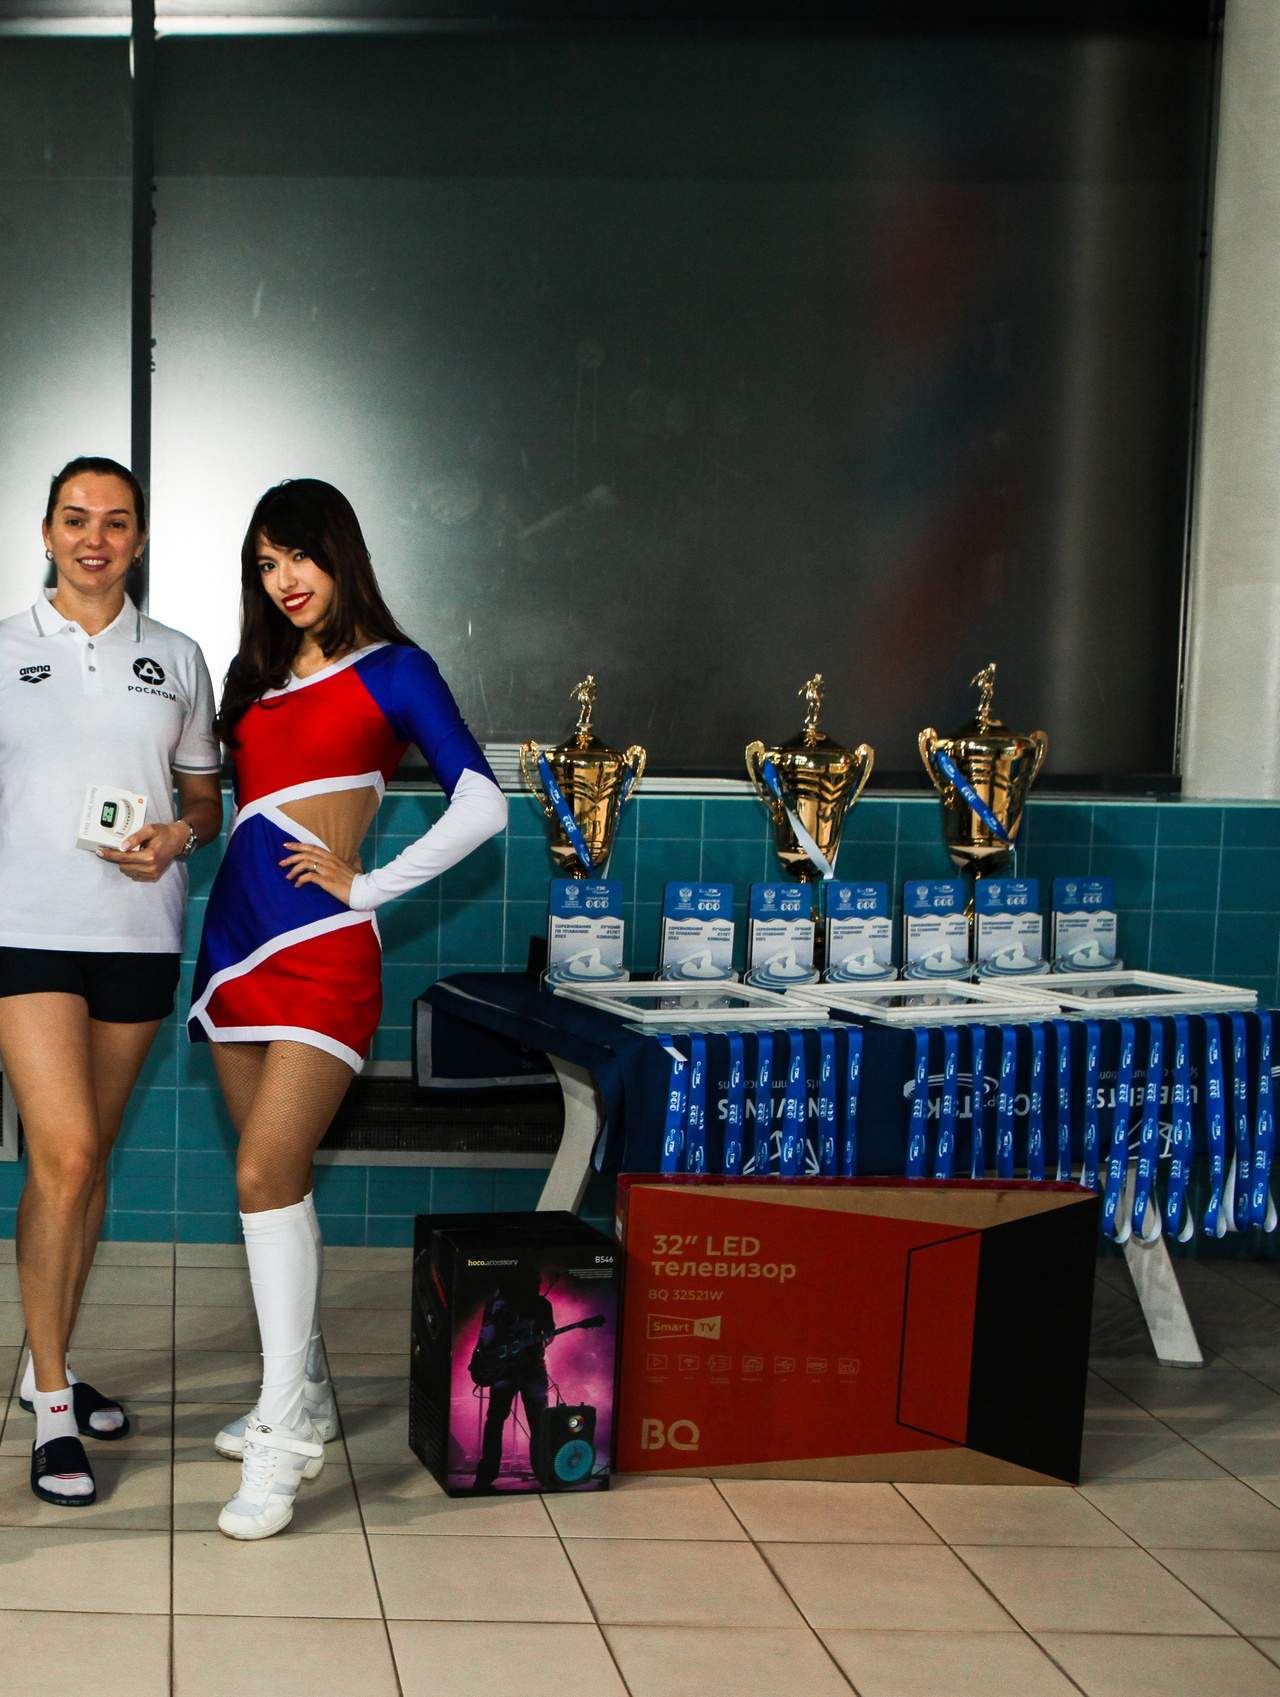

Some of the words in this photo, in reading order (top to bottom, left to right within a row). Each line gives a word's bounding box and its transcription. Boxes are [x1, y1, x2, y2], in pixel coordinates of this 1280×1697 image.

[19, 664, 51, 676] arena
[127, 685, 177, 702] РОСАТОМ
[706, 1235, 761, 1256] LED
[594, 1255, 614, 1264] BS46
[651, 1261, 797, 1283] телевизор
[648, 1289, 668, 1301] BQ
[672, 1289, 723, 1301] 32S21W
[652, 1322, 690, 1332] Smart
[699, 1322, 717, 1332] TV
[641, 1418, 700, 1451] BQ
